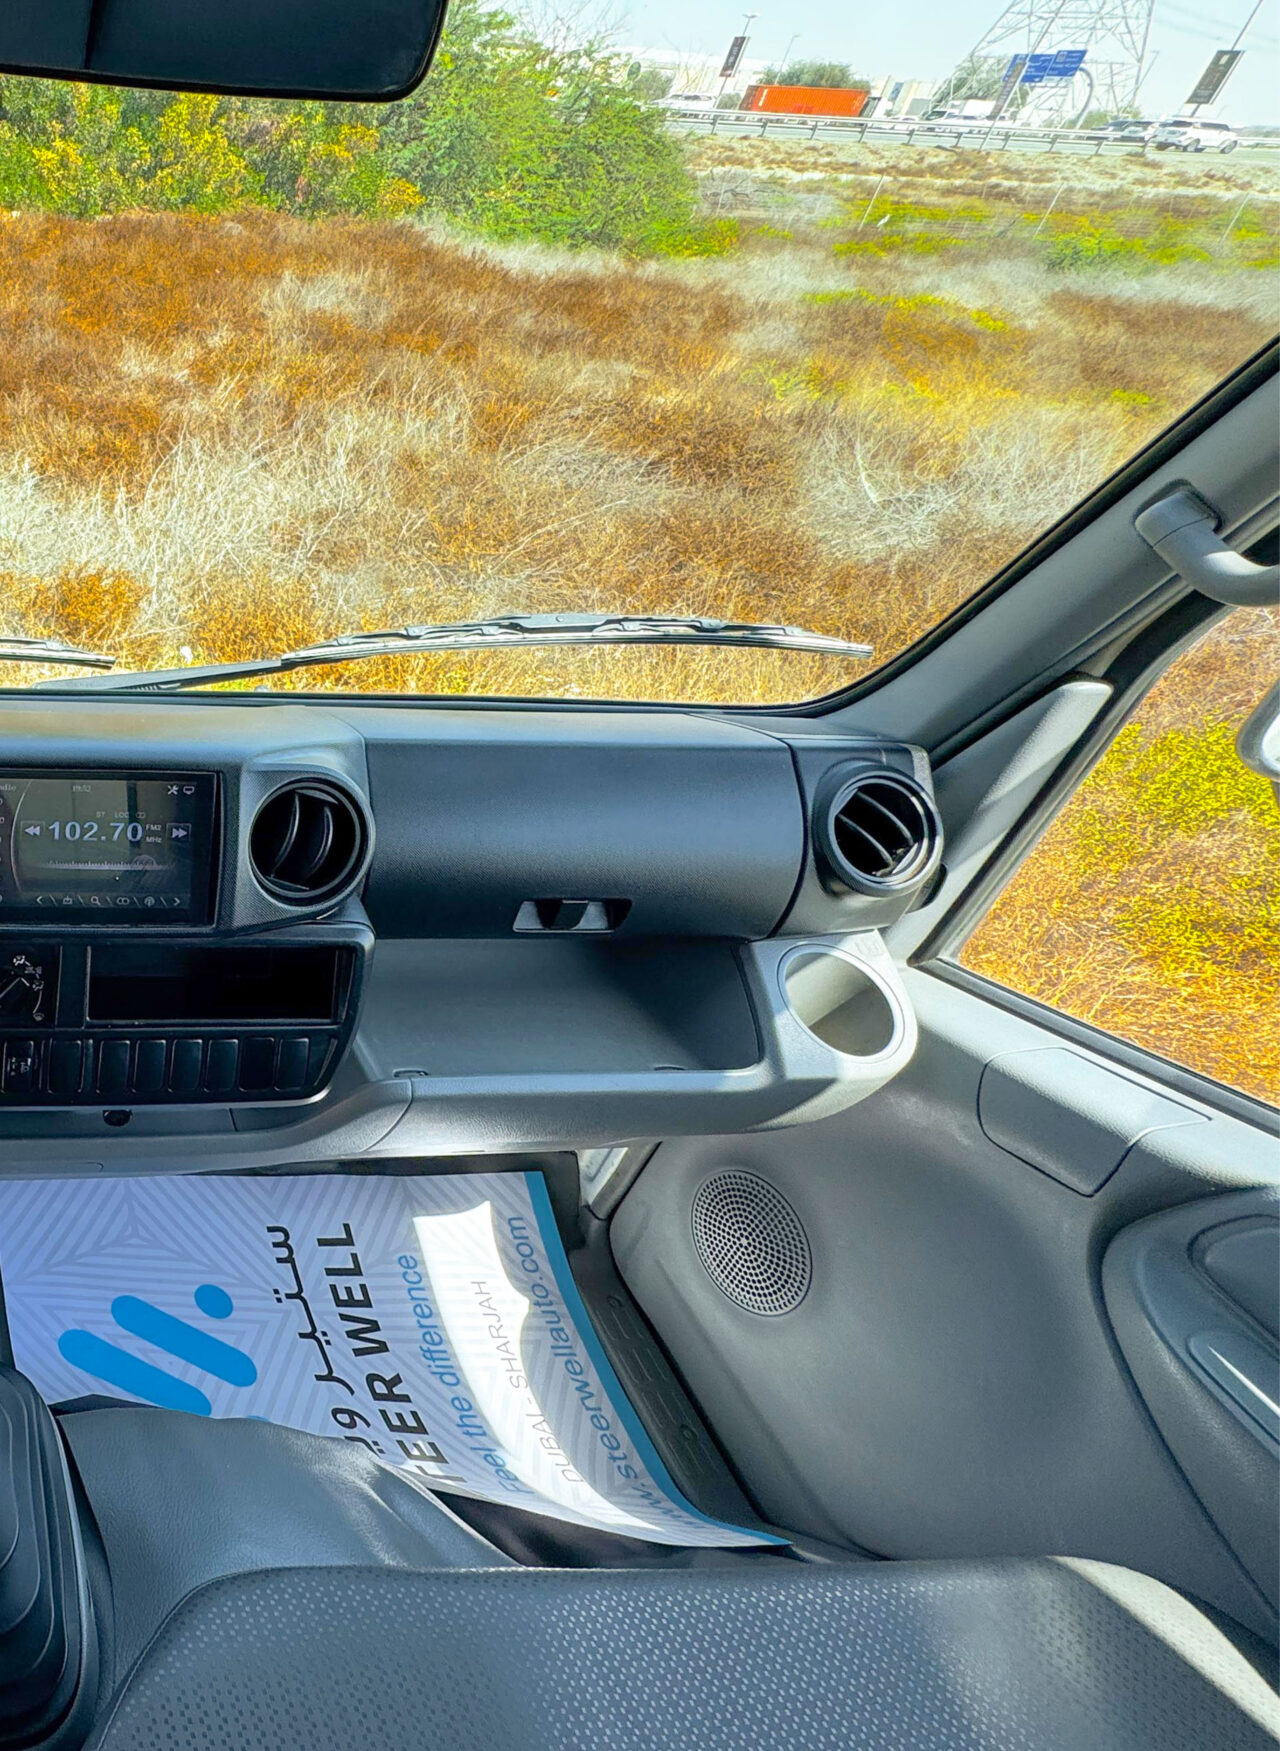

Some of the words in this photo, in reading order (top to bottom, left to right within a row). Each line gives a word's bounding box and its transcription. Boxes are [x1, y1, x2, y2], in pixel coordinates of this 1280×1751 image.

[48, 821, 144, 842] 102.70
[145, 824, 162, 832] FM2
[316, 1222, 390, 1357] WELL
[397, 1253, 460, 1387] difference
[470, 1281, 528, 1389] SHARJAH
[365, 1372, 468, 1483] TEER
[451, 1396, 488, 1438] the
[526, 1412, 585, 1484] DUBAI
[476, 1446, 535, 1495] Feel
